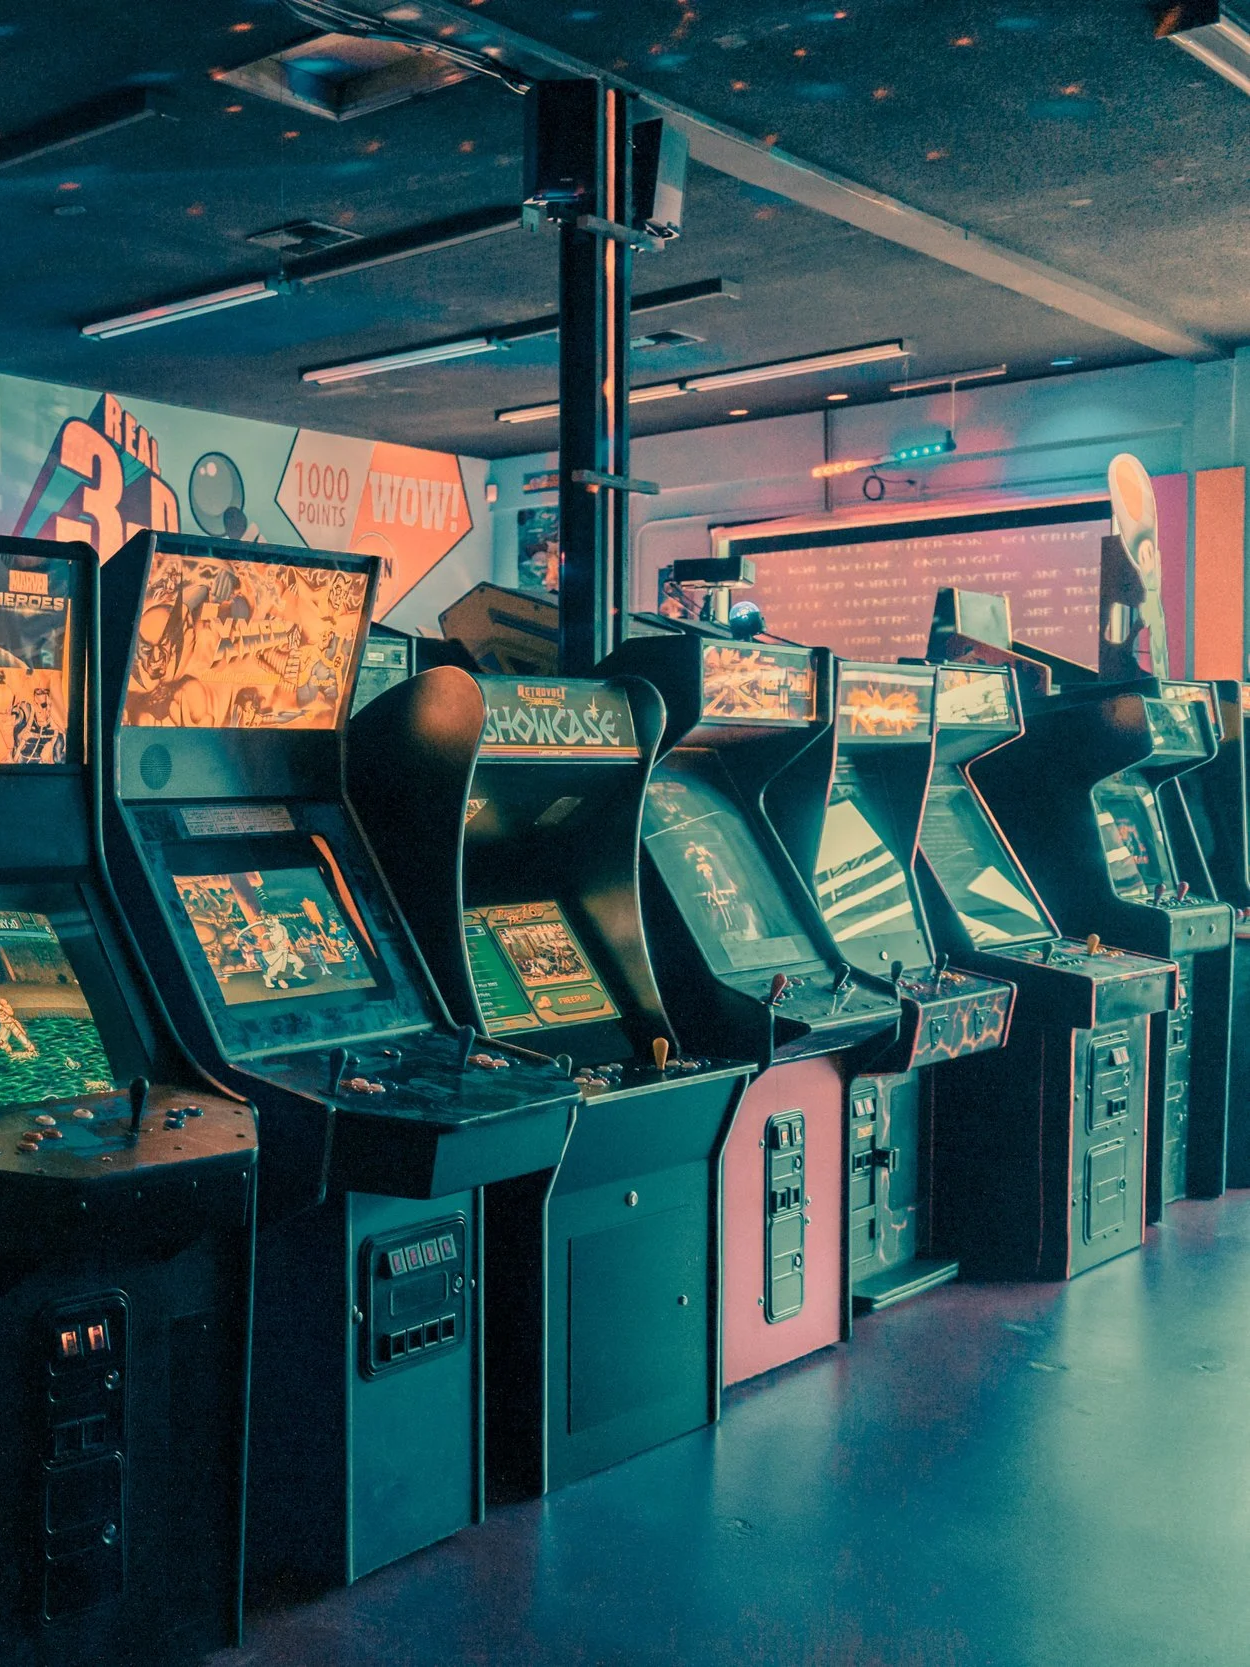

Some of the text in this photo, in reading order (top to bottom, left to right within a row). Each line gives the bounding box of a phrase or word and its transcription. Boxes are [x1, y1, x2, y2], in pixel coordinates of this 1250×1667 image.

[105, 393, 161, 477] REAL
[295, 462, 350, 502] 1000
[297, 501, 347, 528] POINTS
[368, 471, 461, 534] WOW!
[483, 706, 620, 746] SHOWCASE
